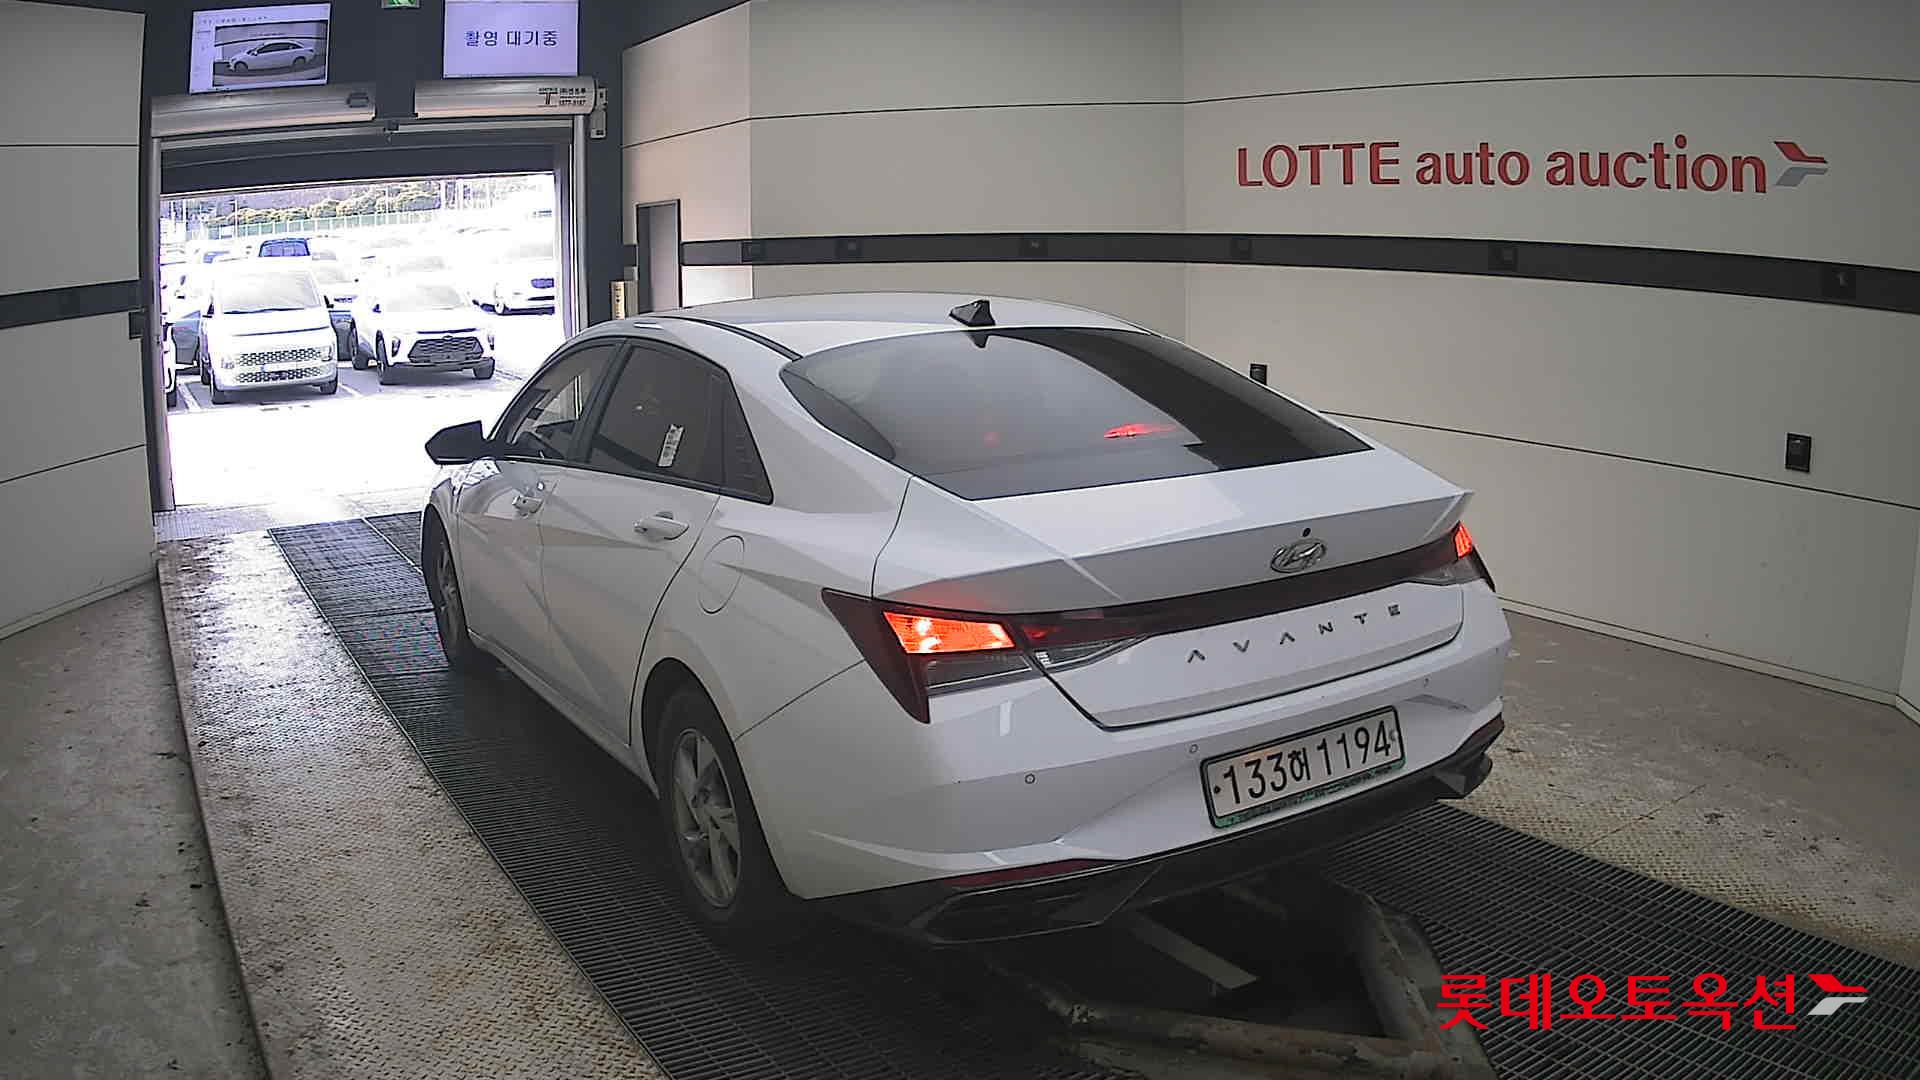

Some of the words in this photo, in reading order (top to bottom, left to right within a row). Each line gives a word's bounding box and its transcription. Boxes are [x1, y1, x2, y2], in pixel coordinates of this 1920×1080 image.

[506, 30, 558, 47] 대기중
[1237, 142, 1400, 187] LOTTE
[1416, 142, 1530, 185] auto
[1546, 134, 1767, 193] auction
[1187, 603, 1401, 664] AVANTE
